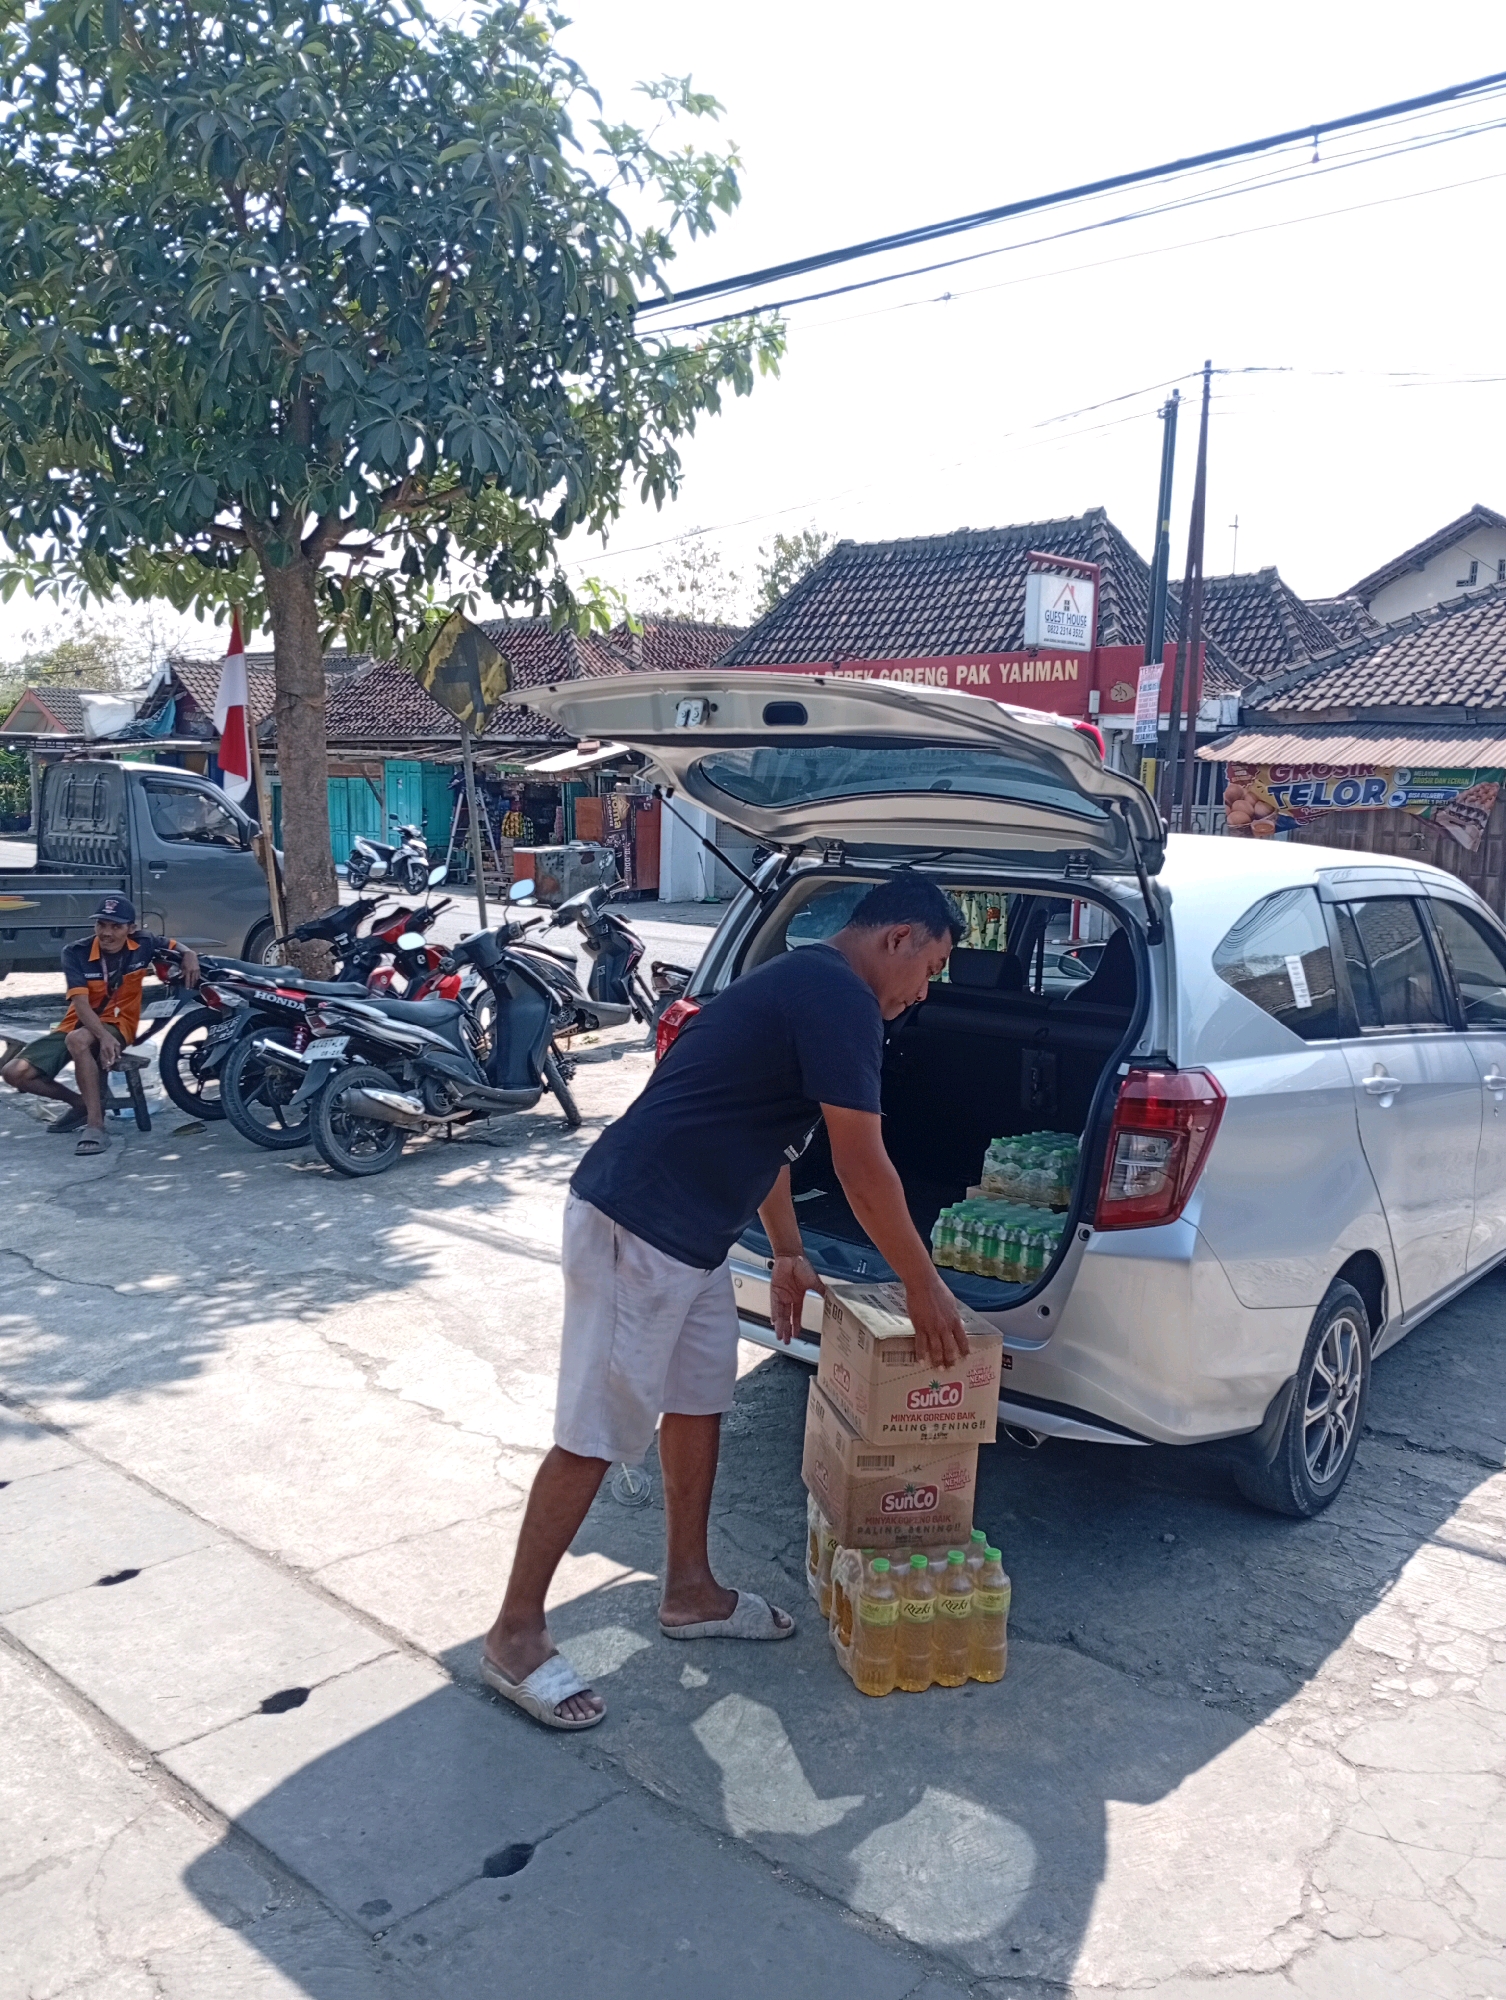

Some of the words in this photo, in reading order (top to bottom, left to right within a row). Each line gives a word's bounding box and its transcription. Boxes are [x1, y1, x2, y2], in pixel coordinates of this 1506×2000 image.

[1044, 609, 1065, 624] GUEST
[1066, 613, 1087, 627] HOUSE
[956, 664, 991, 685] PAK
[999, 659, 1079, 683] YAHMAN
[1269, 763, 1376, 784] GROSIR
[1267, 778, 1387, 809] TELOR
[254, 990, 307, 1012] HONDA
[910, 1385, 960, 1408] SunCo
[890, 1414, 922, 1423] MINYAK
[923, 1412, 956, 1422] GORENG
[957, 1411, 976, 1420] BAIK
[882, 1423, 927, 1432] PALING
[885, 1489, 934, 1511] SunCo
[864, 1516, 898, 1525] MINYAK
[933, 1514, 951, 1523] BAIK
[857, 1526, 901, 1536] PALING
[903, 1602, 931, 1618] Rizki
[941, 1599, 969, 1613] Rizki
